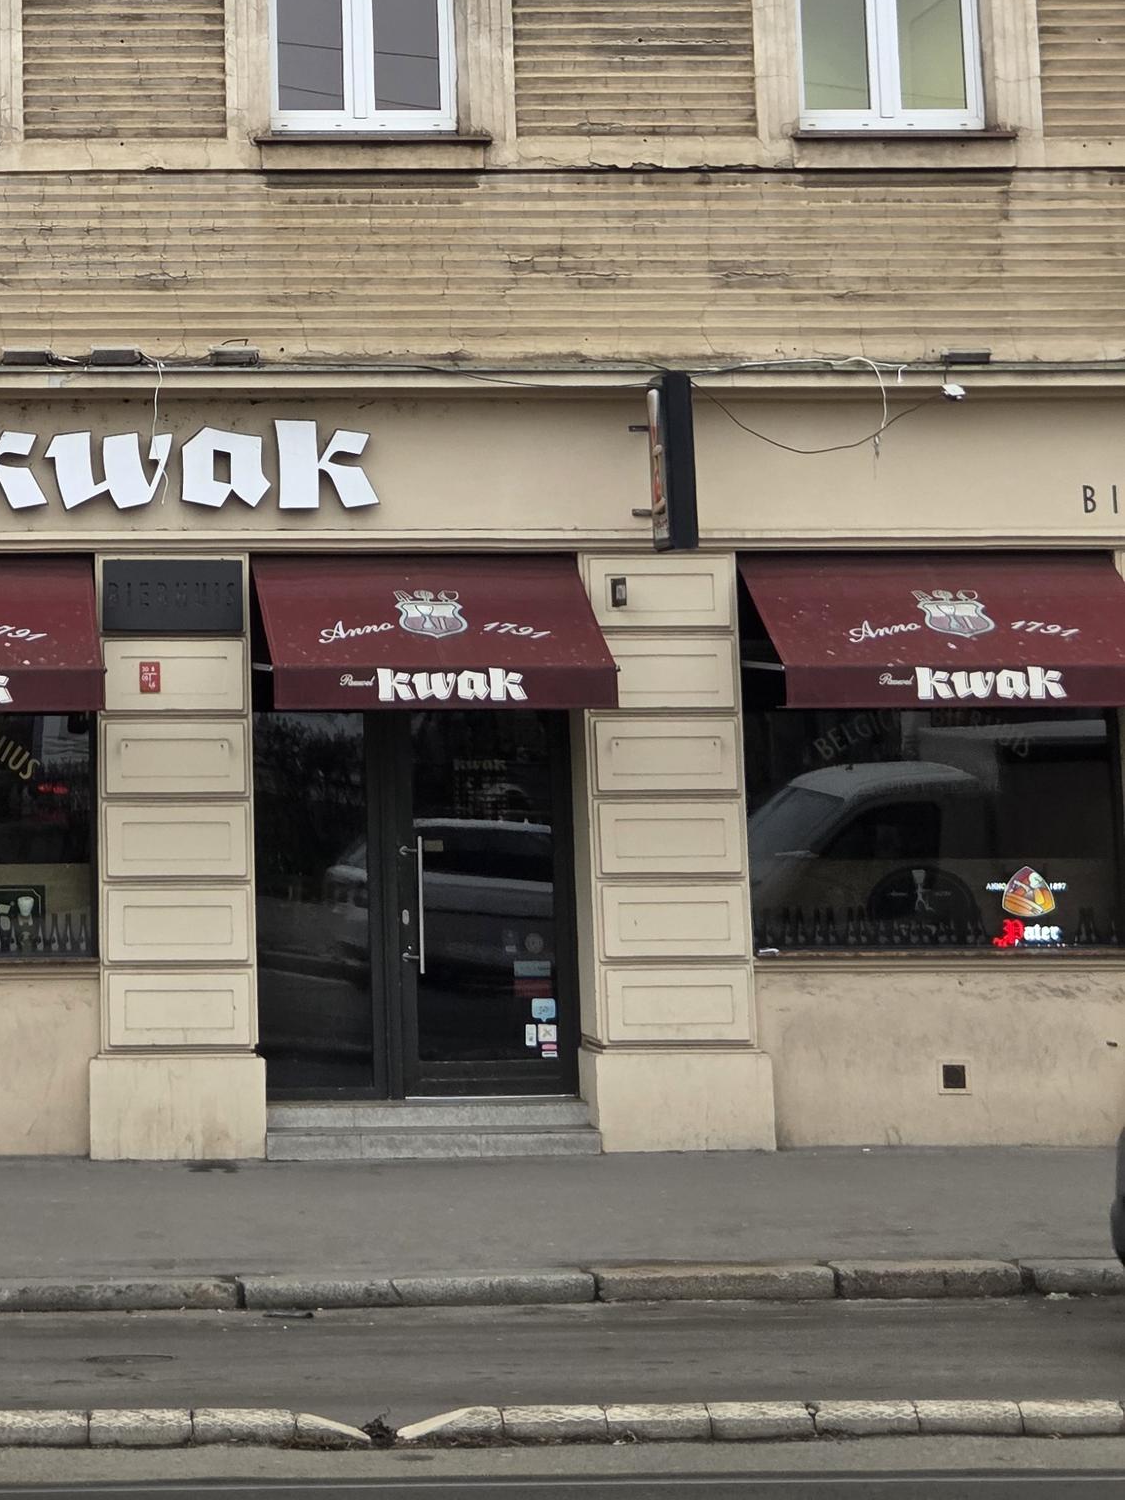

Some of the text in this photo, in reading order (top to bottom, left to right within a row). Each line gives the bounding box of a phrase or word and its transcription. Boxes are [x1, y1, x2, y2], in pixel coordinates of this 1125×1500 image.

[319, 620, 552, 644] Anno 1791
[849, 619, 1080, 643] Anno 1791
[376, 667, 528, 701] kwak
[915, 665, 1067, 700] kwak
